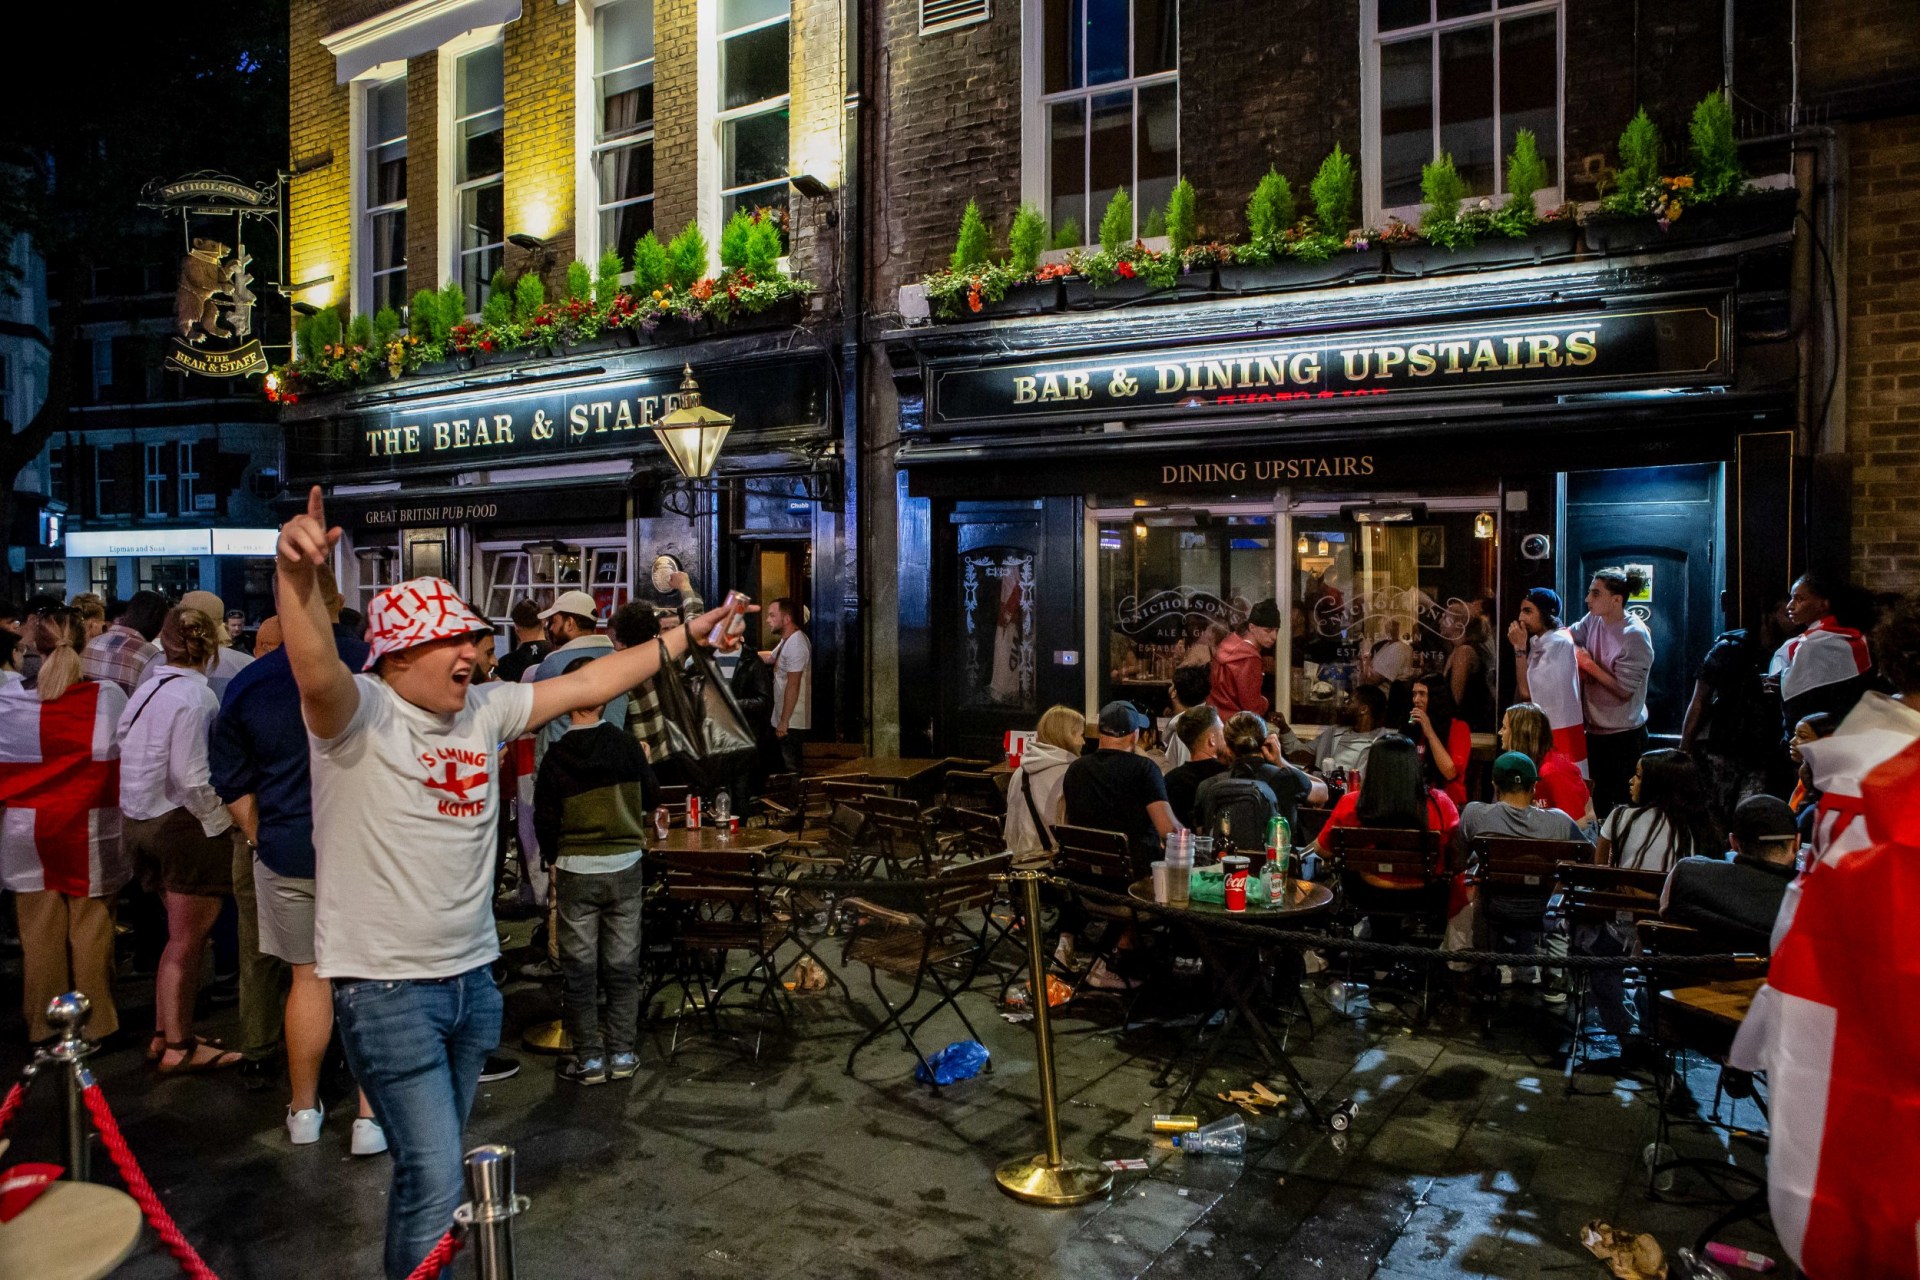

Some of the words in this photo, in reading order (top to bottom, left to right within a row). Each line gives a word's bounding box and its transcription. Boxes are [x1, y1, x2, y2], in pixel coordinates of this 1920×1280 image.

[164, 182, 257, 201] NICHOLSON'S
[175, 350, 207, 372] BEAR
[208, 363, 218, 373] &
[220, 352, 257, 372] STAFF
[205, 354, 230, 363] THE
[1013, 370, 1093, 404] BAR
[1108, 365, 1139, 398] &
[1155, 352, 1322, 394] DINING
[1340, 330, 1597, 381] UPSTAIRS
[366, 425, 421, 457] THE
[433, 414, 515, 451] BEAR
[531, 409, 555, 440] &
[569, 393, 682, 437] STAFF
[1161, 462, 1247, 484] DINING
[1254, 455, 1375, 480] UPSTAIRS
[366, 510, 398, 524] GREAT
[399, 507, 440, 522] BRITISH
[441, 505, 464, 519] PUB
[466, 504, 498, 518] FOOD
[109, 545, 135, 554] Lipman
[135, 545, 148, 553] and
[1131, 598, 1241, 625] NICHOLSON'S
[1329, 598, 1456, 627] NICHOLON'S
[1157, 628, 1177, 637] ALE
[1181, 628, 1188, 637] &
[1402, 632, 1422, 642] GN
